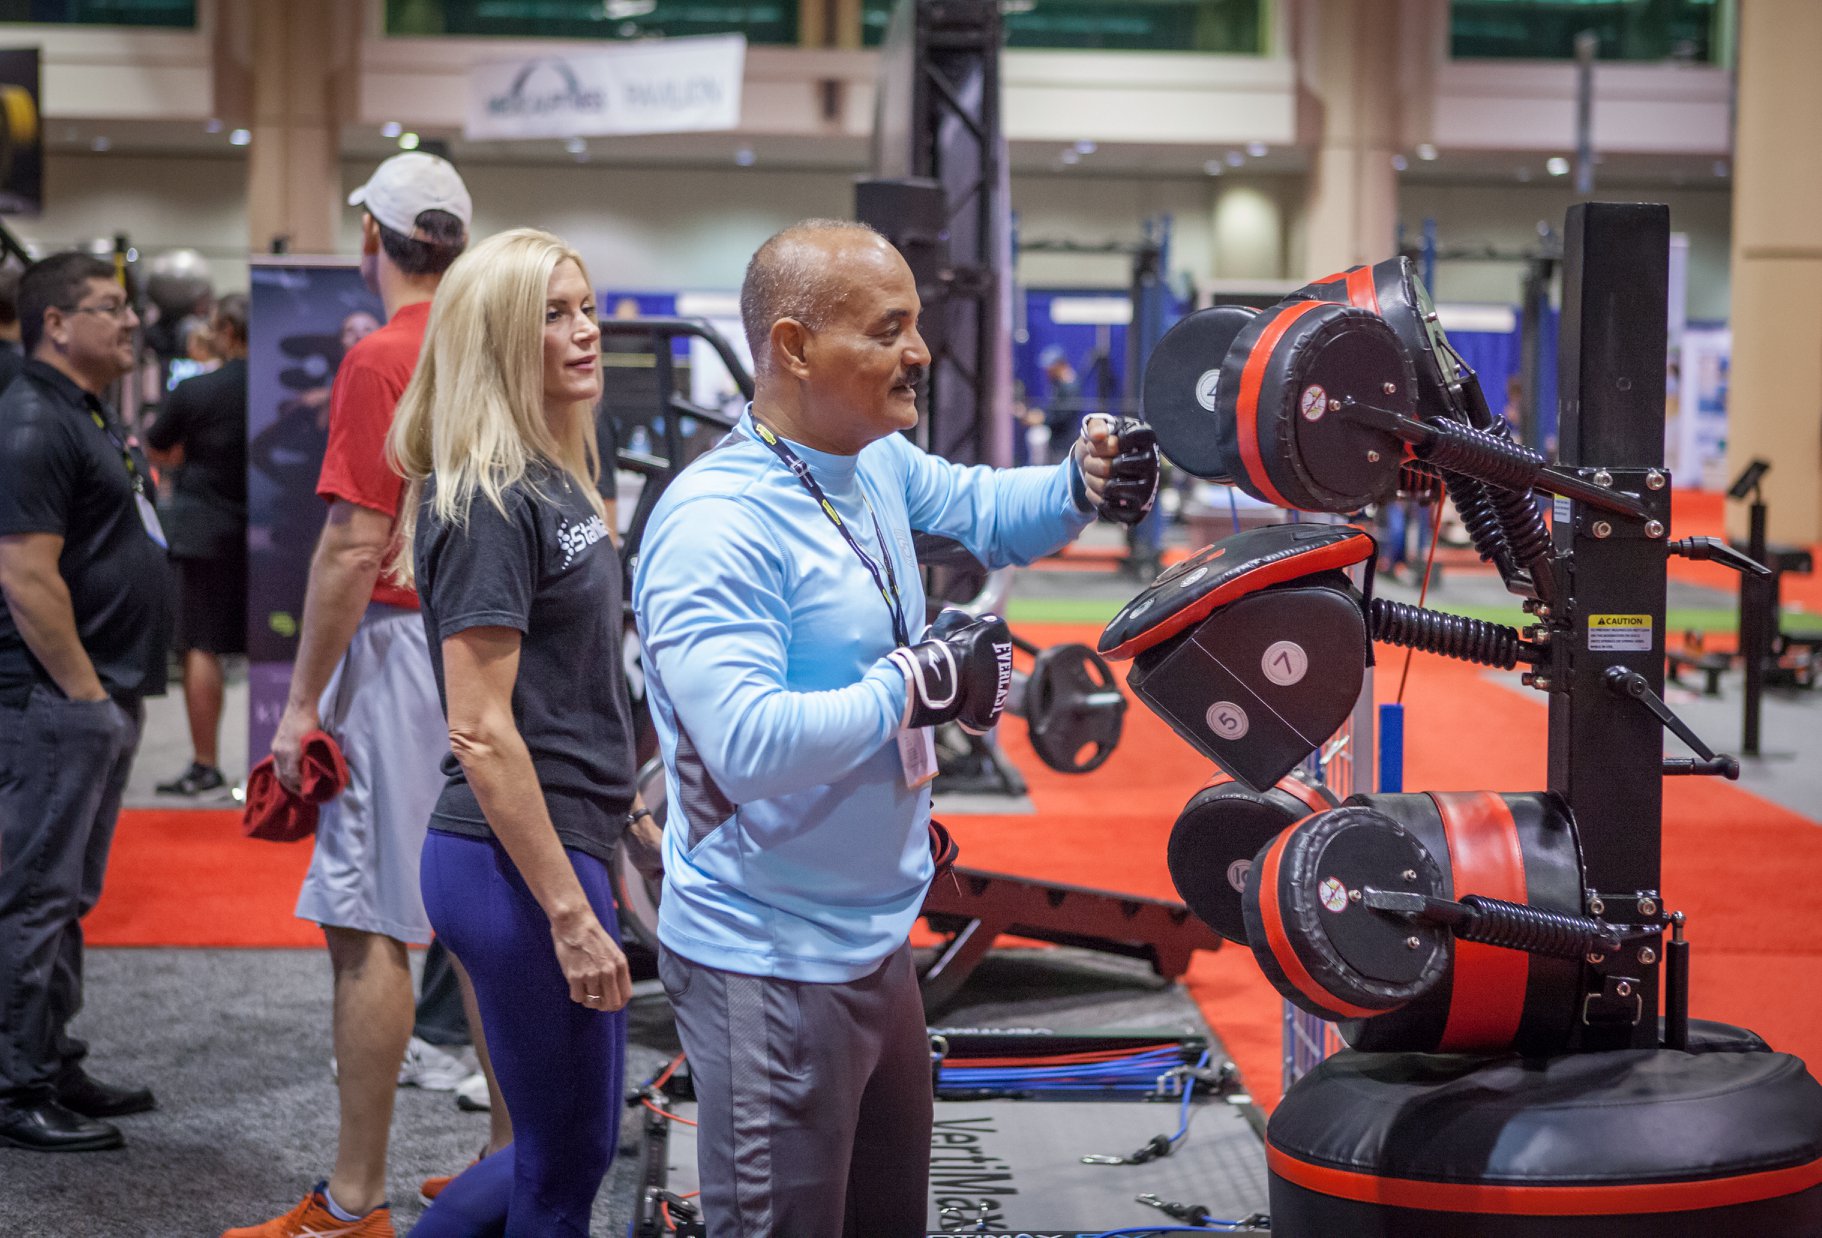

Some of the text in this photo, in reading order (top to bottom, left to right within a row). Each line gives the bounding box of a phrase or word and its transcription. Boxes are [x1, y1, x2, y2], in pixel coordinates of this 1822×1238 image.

[1606, 617, 1643, 625] CAUTION
[1273, 650, 1292, 675] 7
[991, 641, 1012, 714] EVERLAST
[1218, 712, 1238, 730] 5
[931, 1116, 1020, 1232] VertiMax
